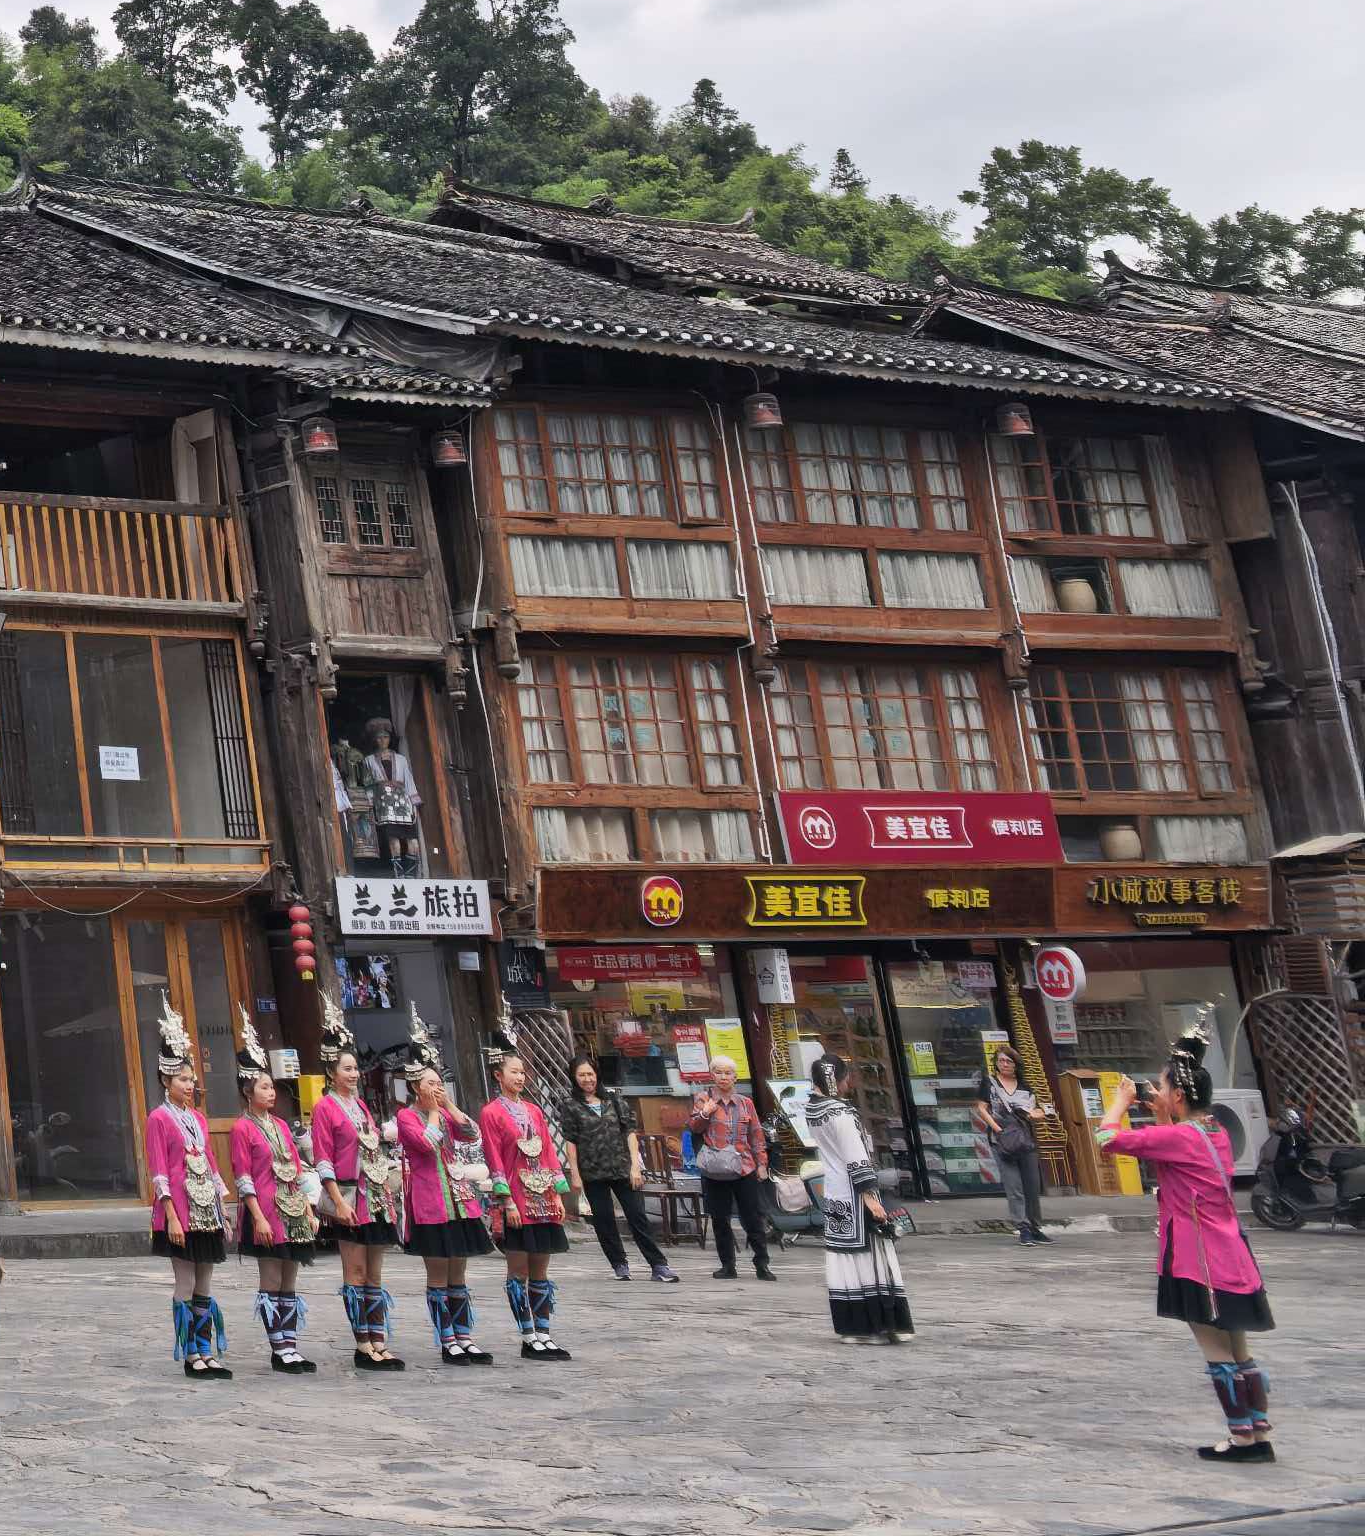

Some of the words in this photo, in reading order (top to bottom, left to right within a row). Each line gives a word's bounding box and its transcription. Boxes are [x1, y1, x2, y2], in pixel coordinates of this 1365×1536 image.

[885, 816, 952, 840] 美宜佳
[991, 819, 1044, 836] 便利店
[352, 883, 480, 918] 兰兰旅拍
[763, 885, 852, 917] 美宜佳
[925, 888, 990, 909] 便利店
[1092, 878, 1241, 905] 小城故事客栈
